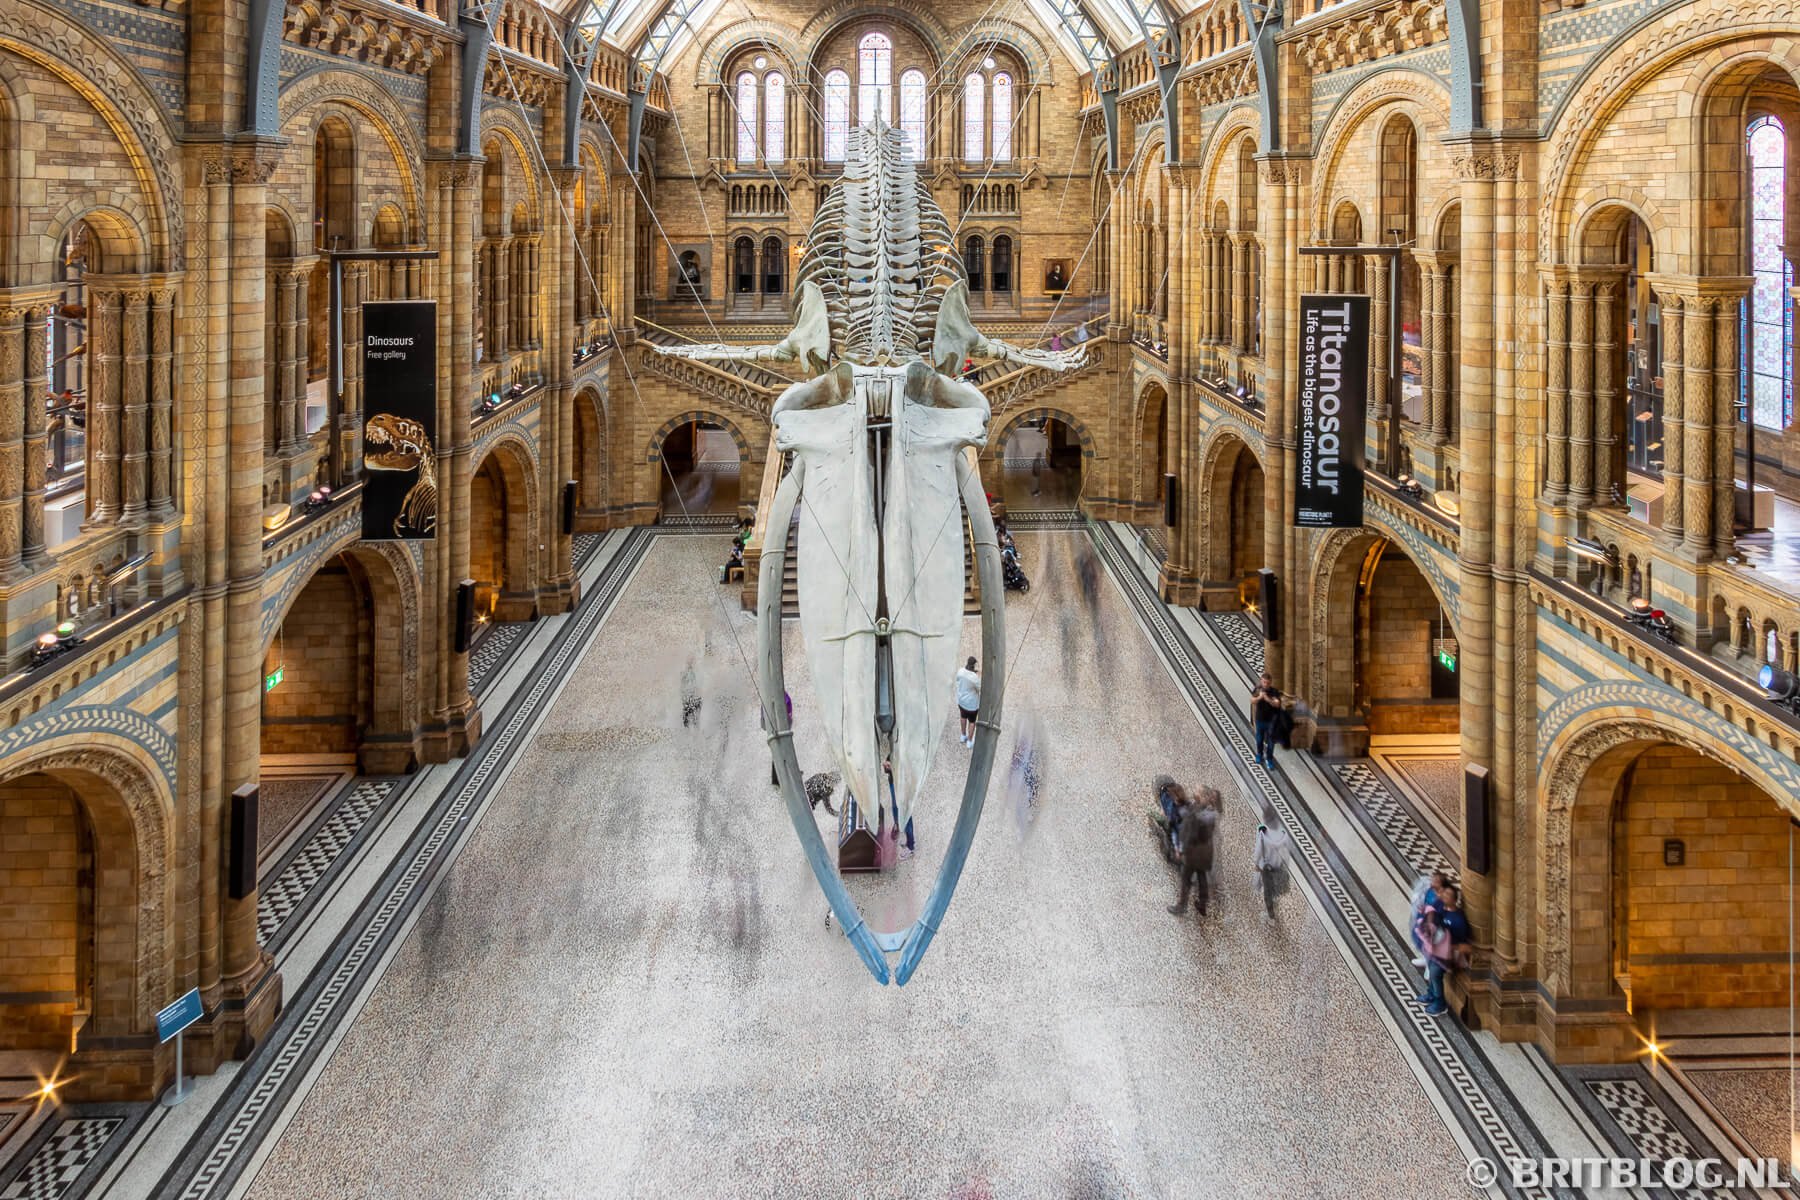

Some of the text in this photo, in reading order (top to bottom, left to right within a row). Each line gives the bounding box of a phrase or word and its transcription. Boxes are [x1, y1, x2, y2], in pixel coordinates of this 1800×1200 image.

[367, 335, 414, 346] Dinosaurs
[367, 350, 406, 361] Free gallery
[1301, 309, 1319, 489] Life as the biggest dinosaur
[1317, 302, 1351, 495] Titanosaur
